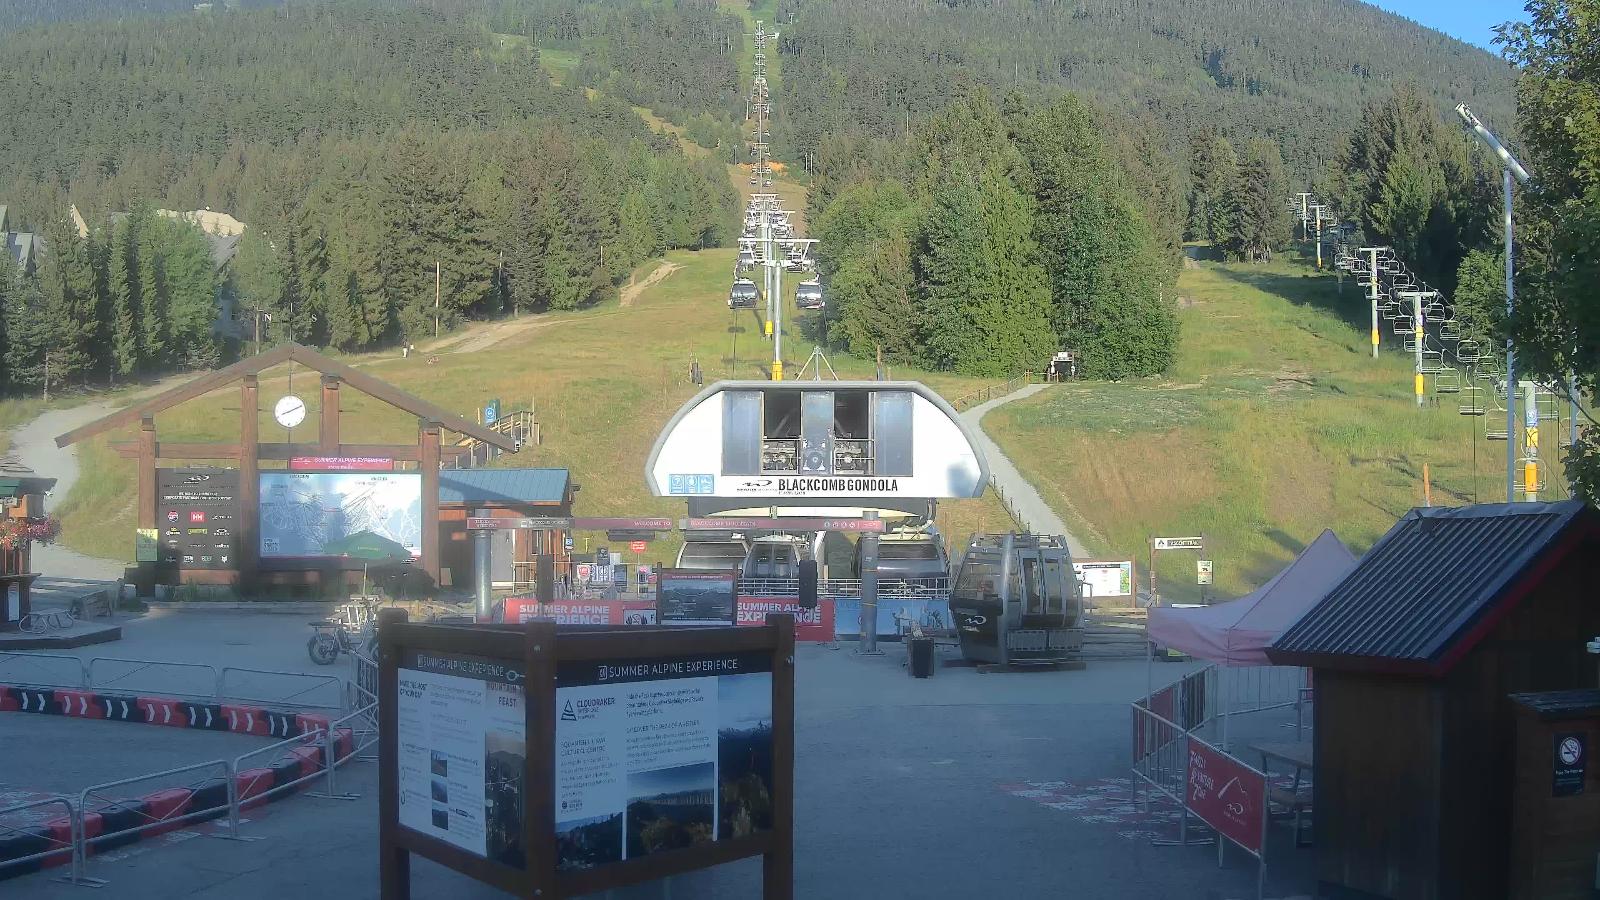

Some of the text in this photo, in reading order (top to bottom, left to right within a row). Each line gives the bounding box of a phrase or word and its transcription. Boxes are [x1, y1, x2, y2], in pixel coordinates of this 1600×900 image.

[264, 313, 272, 321] N
[311, 313, 317, 322] S
[778, 479, 898, 491] BLACKCOMB GONDOLA
[570, 605, 610, 614] ALPINE
[737, 602, 821, 613] SUMMER ALE
[519, 613, 610, 625] ERIENCE
[736, 612, 821, 624] EXPNCE
[609, 658, 738, 678] SUMMER ALPINE EXPERIENCE
[498, 696, 517, 708] FEAST
